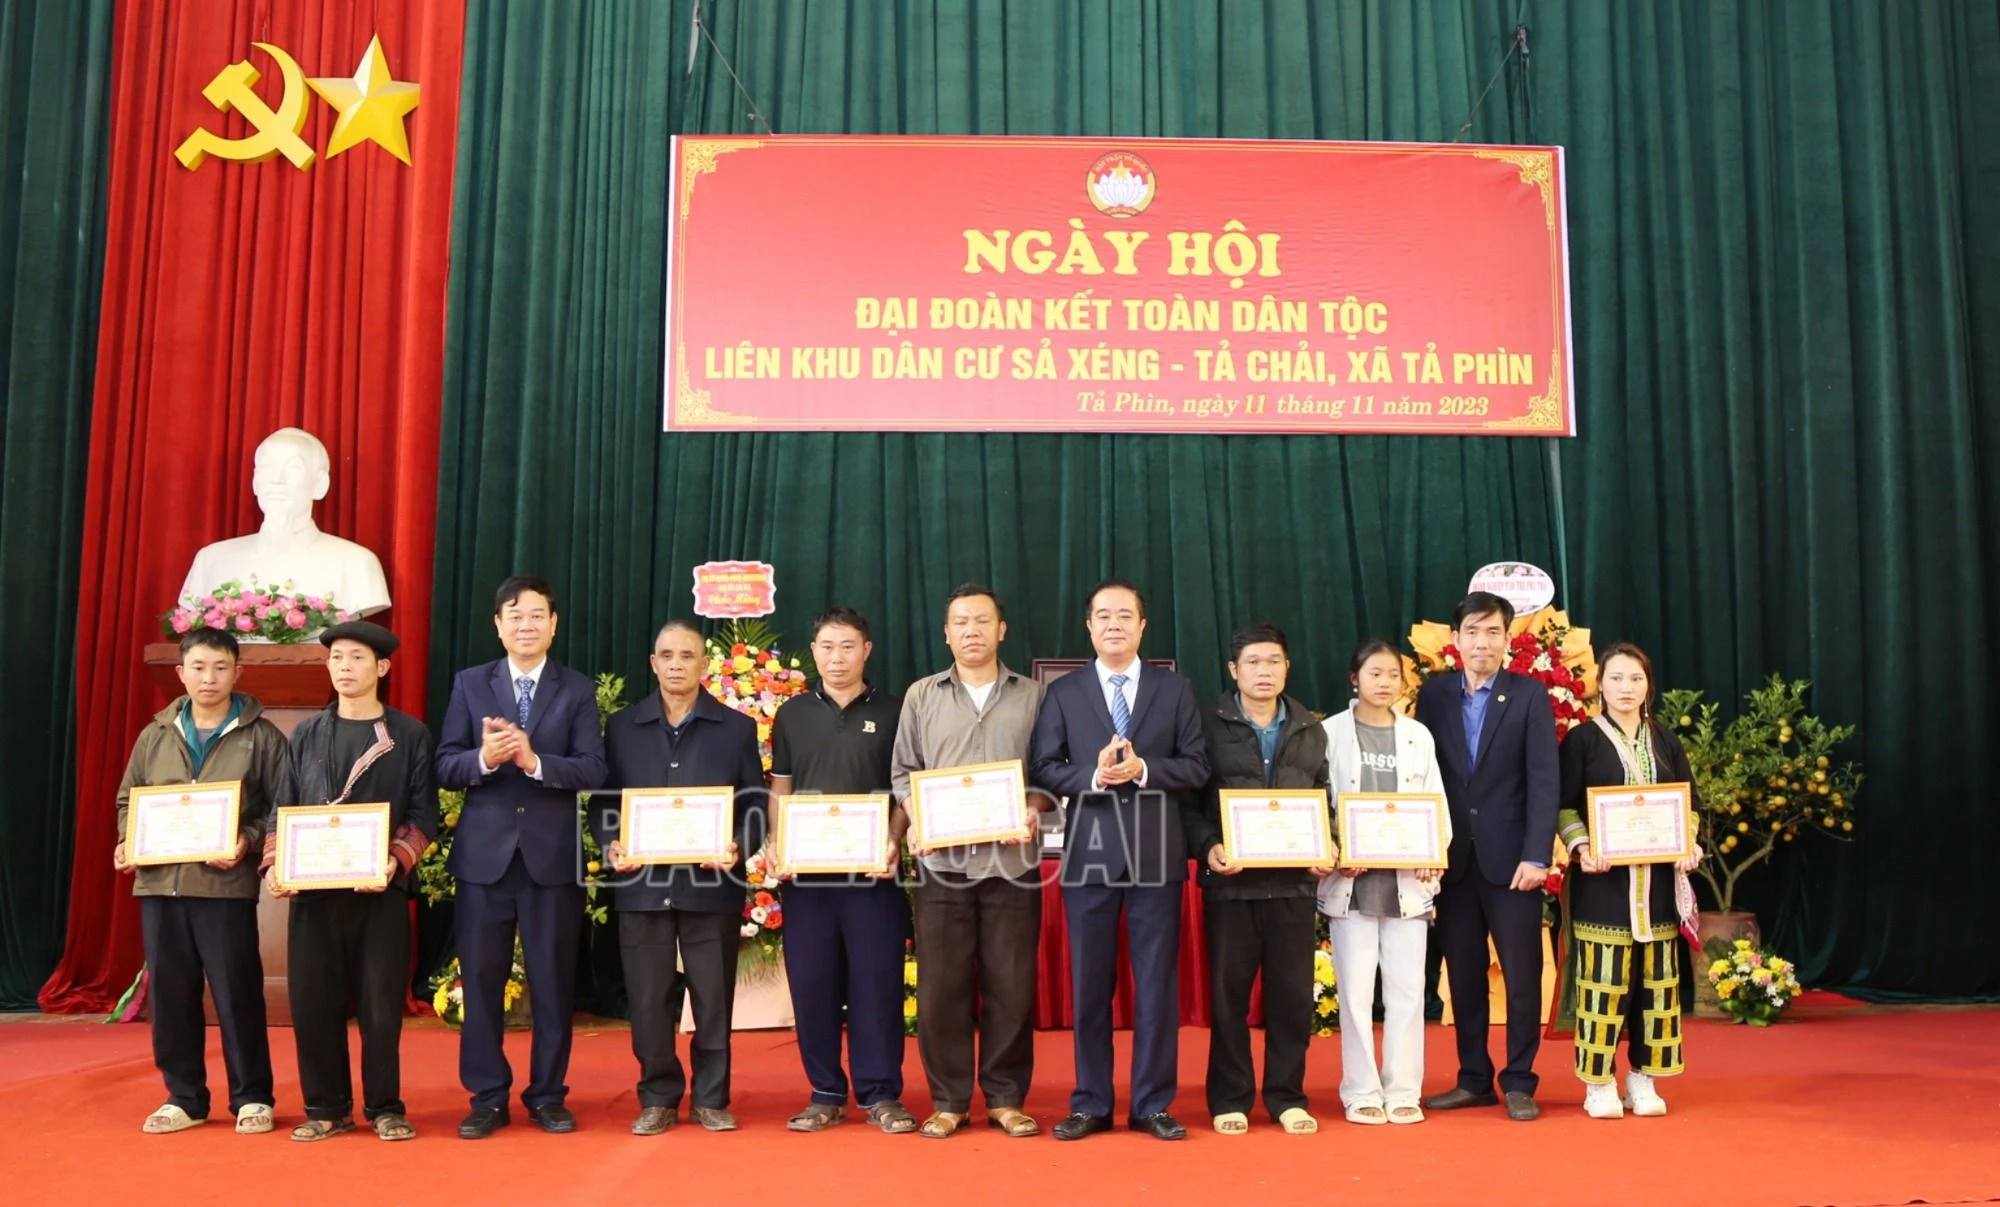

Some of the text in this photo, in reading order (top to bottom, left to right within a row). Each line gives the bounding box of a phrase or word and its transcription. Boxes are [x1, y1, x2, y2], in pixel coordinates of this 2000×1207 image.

[963, 217, 1282, 289] NGÀY HỘI
[856, 289, 1388, 341] ĐẠI ĐOÀN KẾT TOÀN DÂN TỘC
[705, 337, 1534, 387] LIÊN KHU DÂN CƯ SẢ XÉNG - TẢ CHẢI, XÃ TẢ PHÌN
[1077, 390, 1489, 419] Tả Phìn, ngày 11 tháng 11 năm 2023
